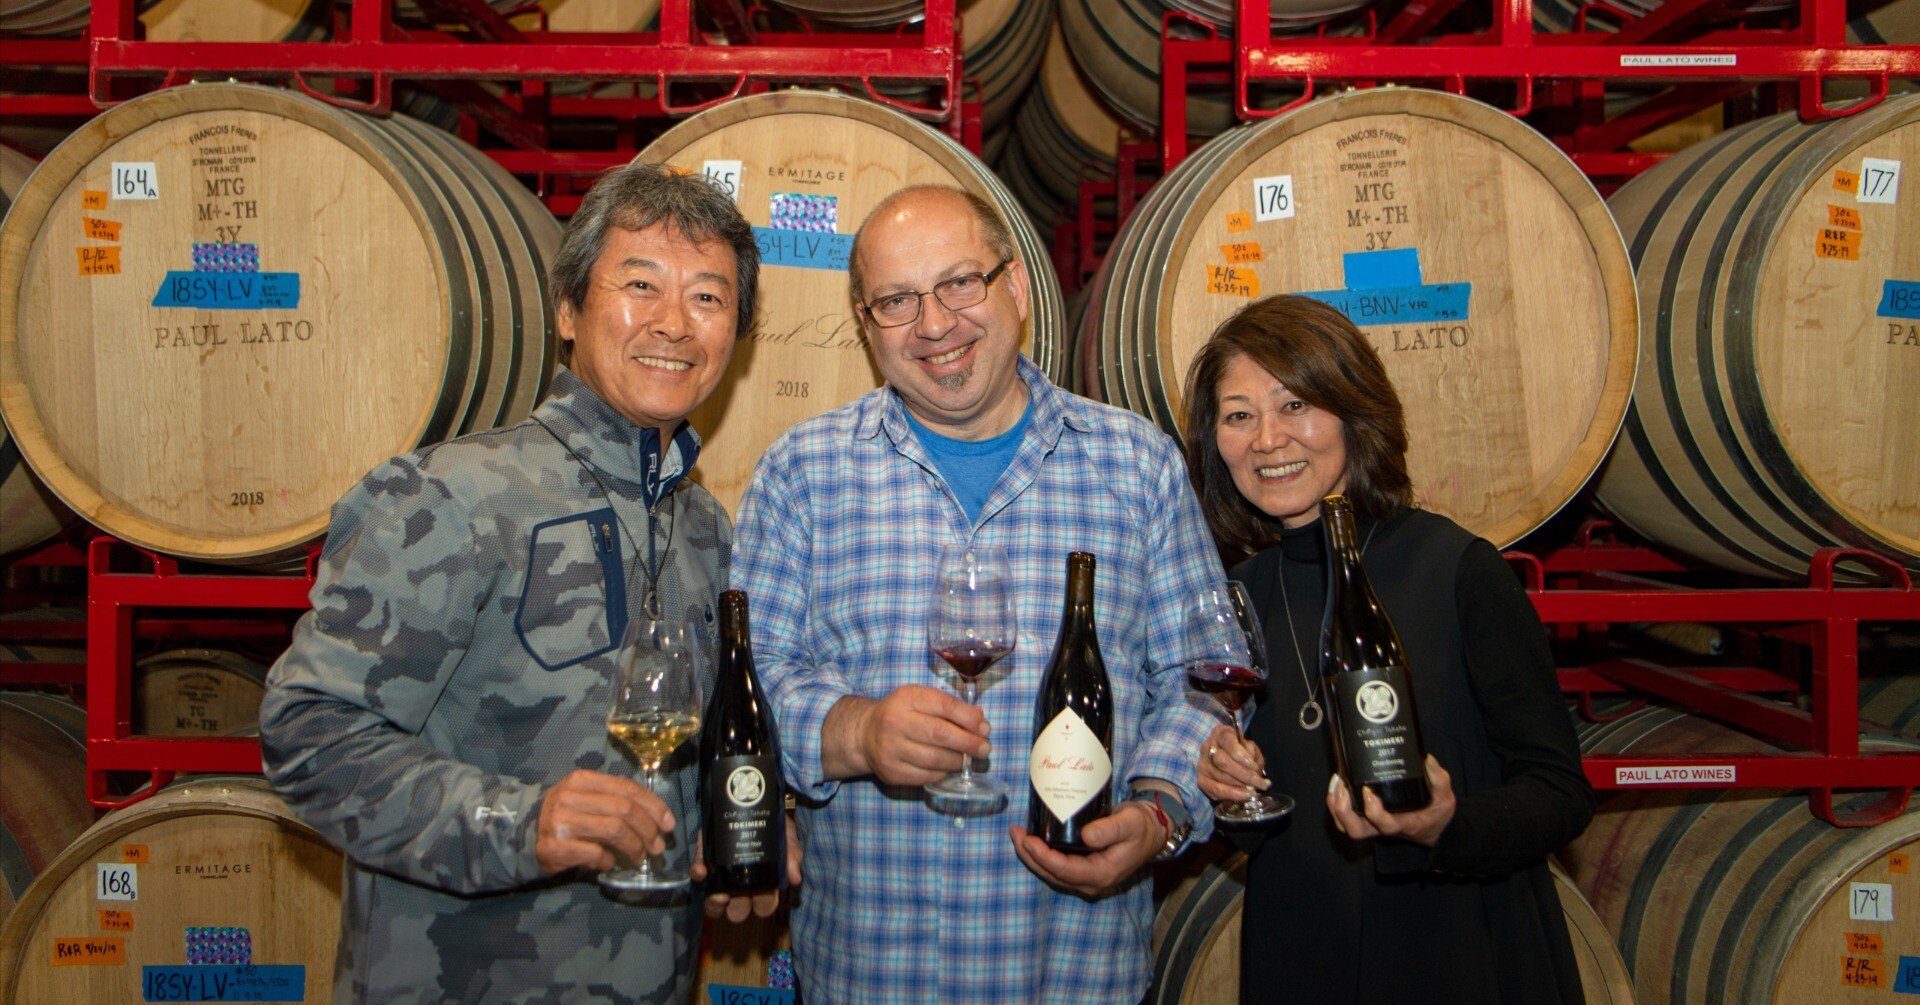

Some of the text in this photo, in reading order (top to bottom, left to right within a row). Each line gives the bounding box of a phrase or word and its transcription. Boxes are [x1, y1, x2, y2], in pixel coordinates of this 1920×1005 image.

[199, 145, 248, 155] TONNELLERIE
[1347, 149, 1398, 160] TONNELLERIE
[209, 165, 240, 174] FRANCE
[768, 166, 845, 182] ERMITAGE
[1358, 170, 1390, 178] FRANCE
[206, 178, 246, 198] MTG
[1864, 168, 1894, 197] 177
[1259, 184, 1288, 214] 176
[1354, 182, 1396, 203] MTG
[216, 226, 242, 244] 3Y
[1365, 232, 1392, 251] 3Y
[1215, 266, 1242, 282] R/R
[155, 320, 314, 348] PAUL LATO
[1392, 326, 1470, 352] LATO
[776, 380, 810, 398] 2018
[230, 491, 265, 506] 2018
[1363, 736, 1404, 748] TOKIMEKI
[1620, 769, 1732, 780] PAUL LATO WINES
[728, 820, 766, 830] TOKIMEKI
[176, 864, 251, 874] ERMITAGE
[1854, 889, 1879, 918] 179
[1846, 957, 1875, 973] R/R
